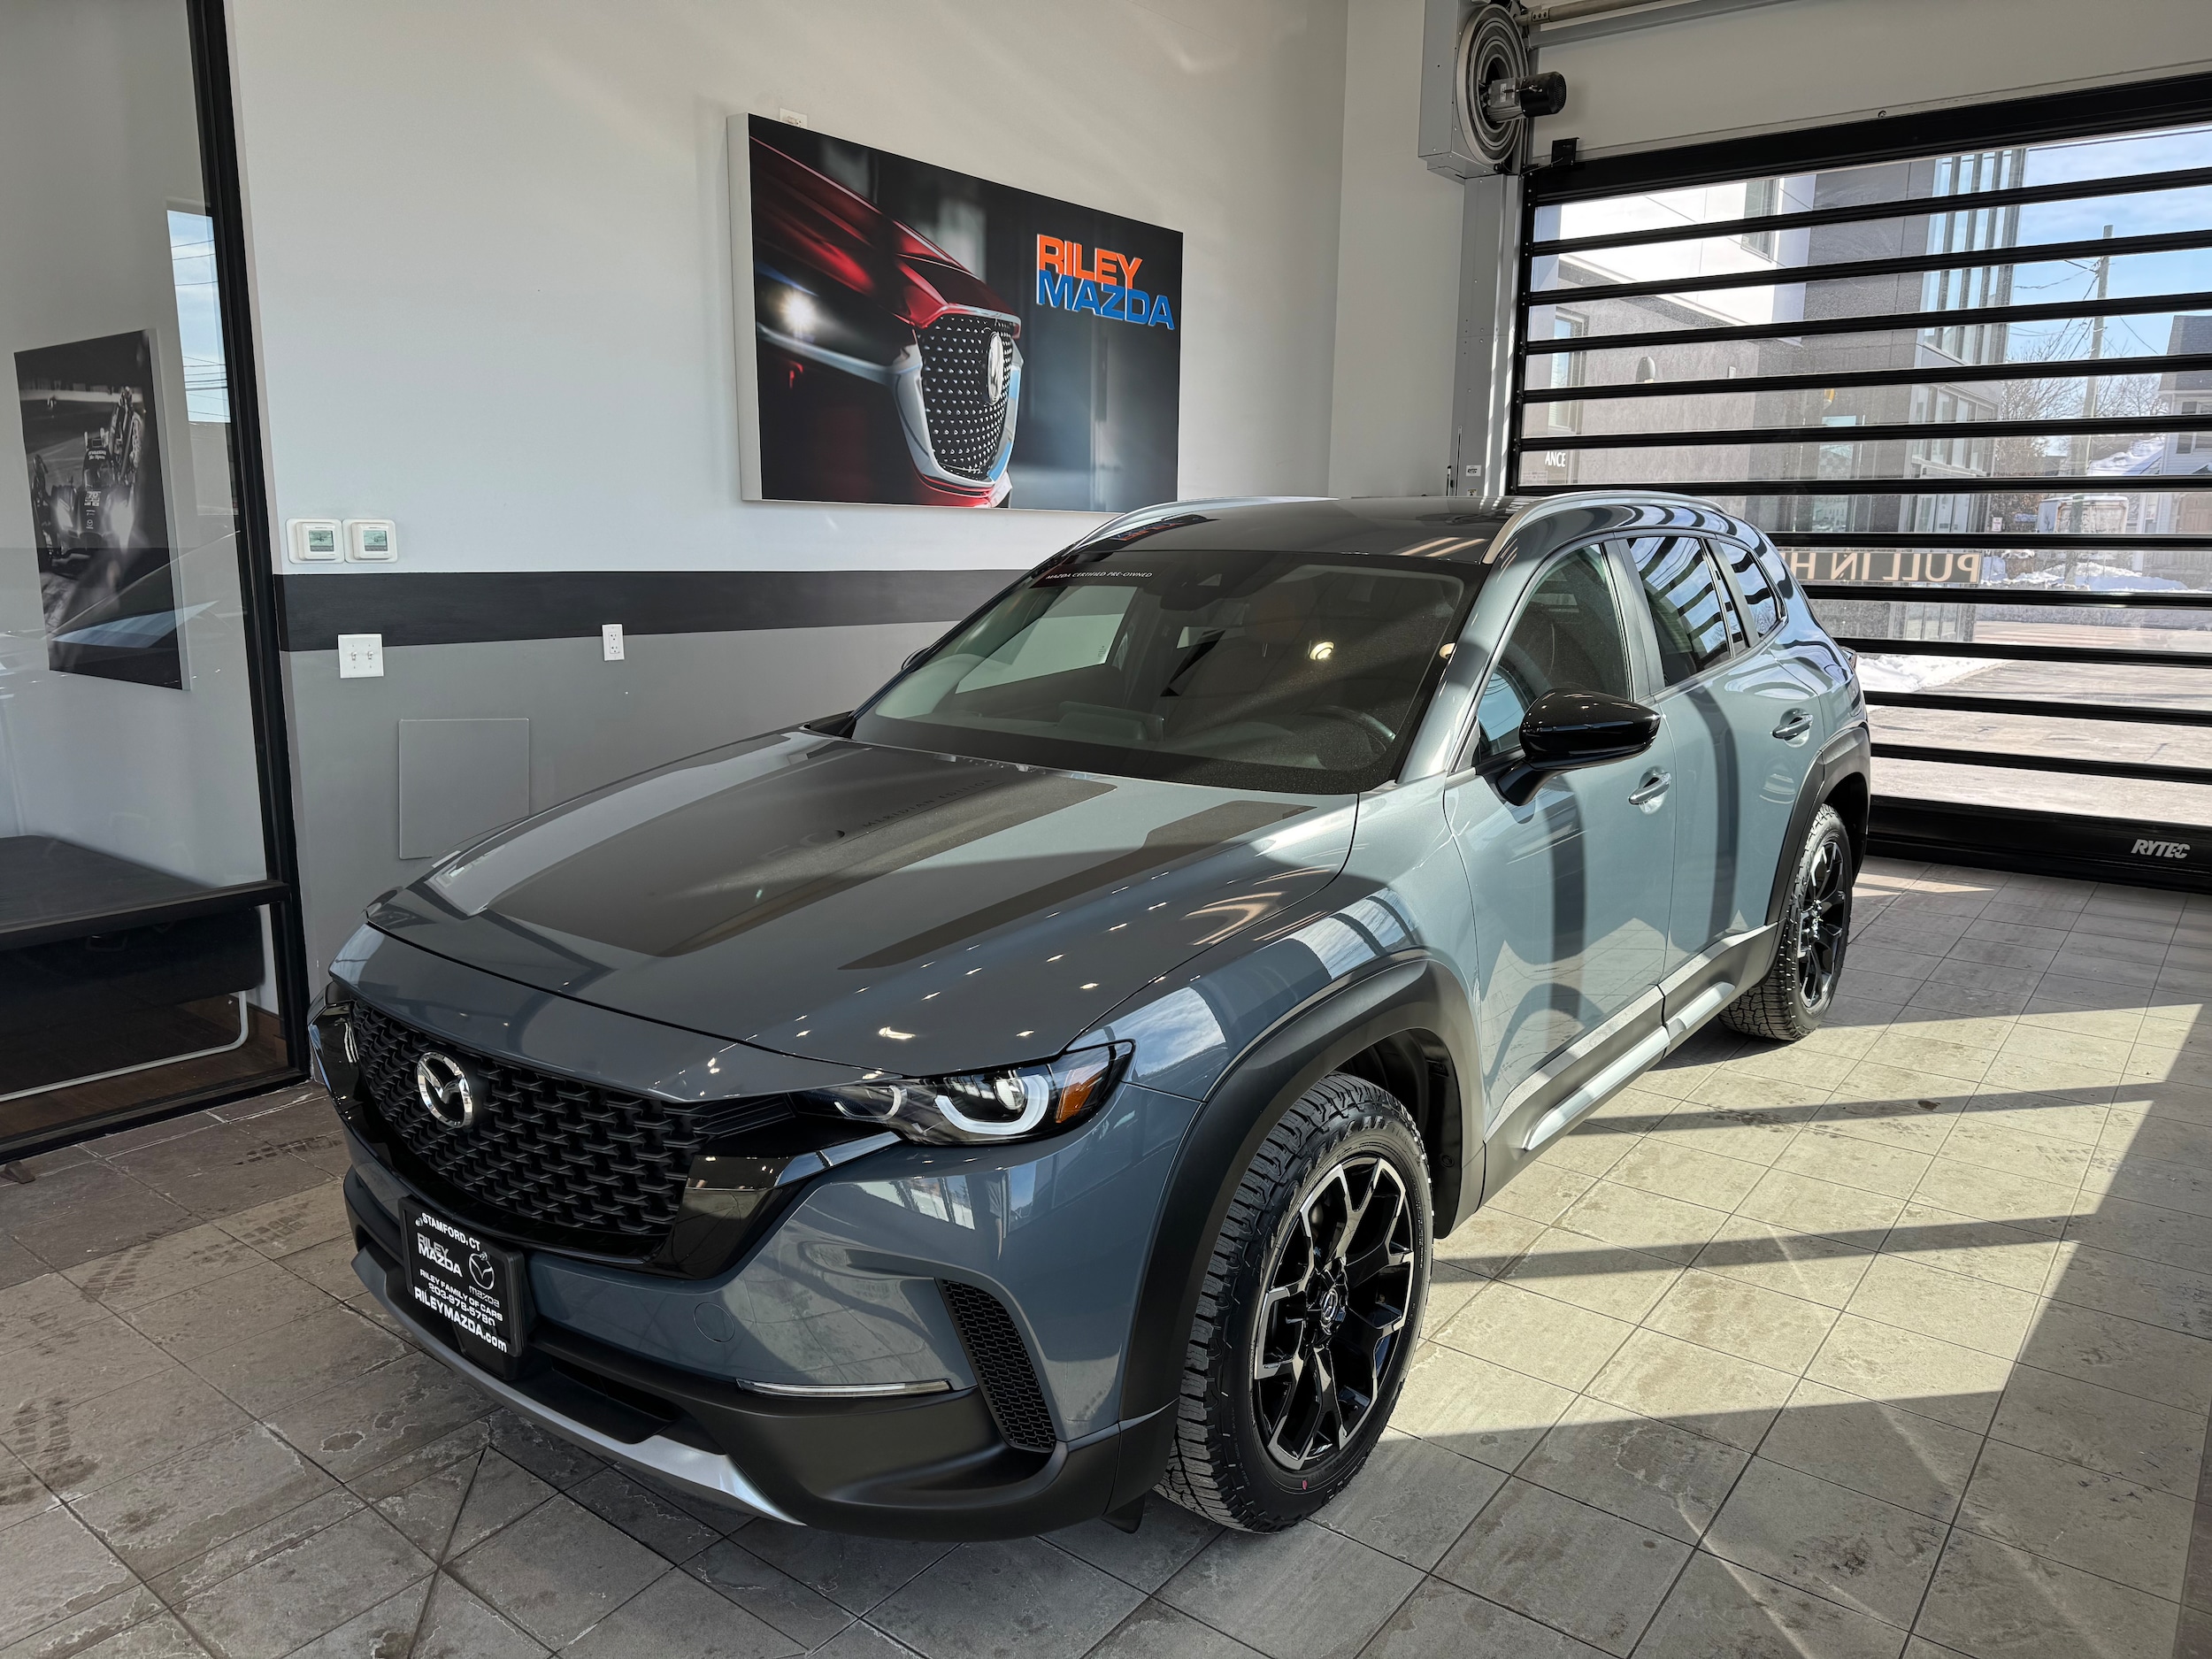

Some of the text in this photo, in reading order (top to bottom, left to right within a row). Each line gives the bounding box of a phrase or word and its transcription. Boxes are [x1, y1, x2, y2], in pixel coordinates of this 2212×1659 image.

[1036, 233, 1143, 290] RILEY
[1036, 268, 1176, 331] MAZDA
[1544, 450, 1566, 467] ANCE
[2131, 839, 2191, 859] RYTEC
[417, 1232, 449, 1260] RILEY
[421, 1212, 481, 1251] STAMFORD, CT
[417, 1241, 463, 1278] MAZDA
[419, 1268, 503, 1322] RILEY FAMILY OF CARS
[468, 1285, 500, 1309] mazda
[414, 1286, 508, 1354] RILEYMAZDA.com
